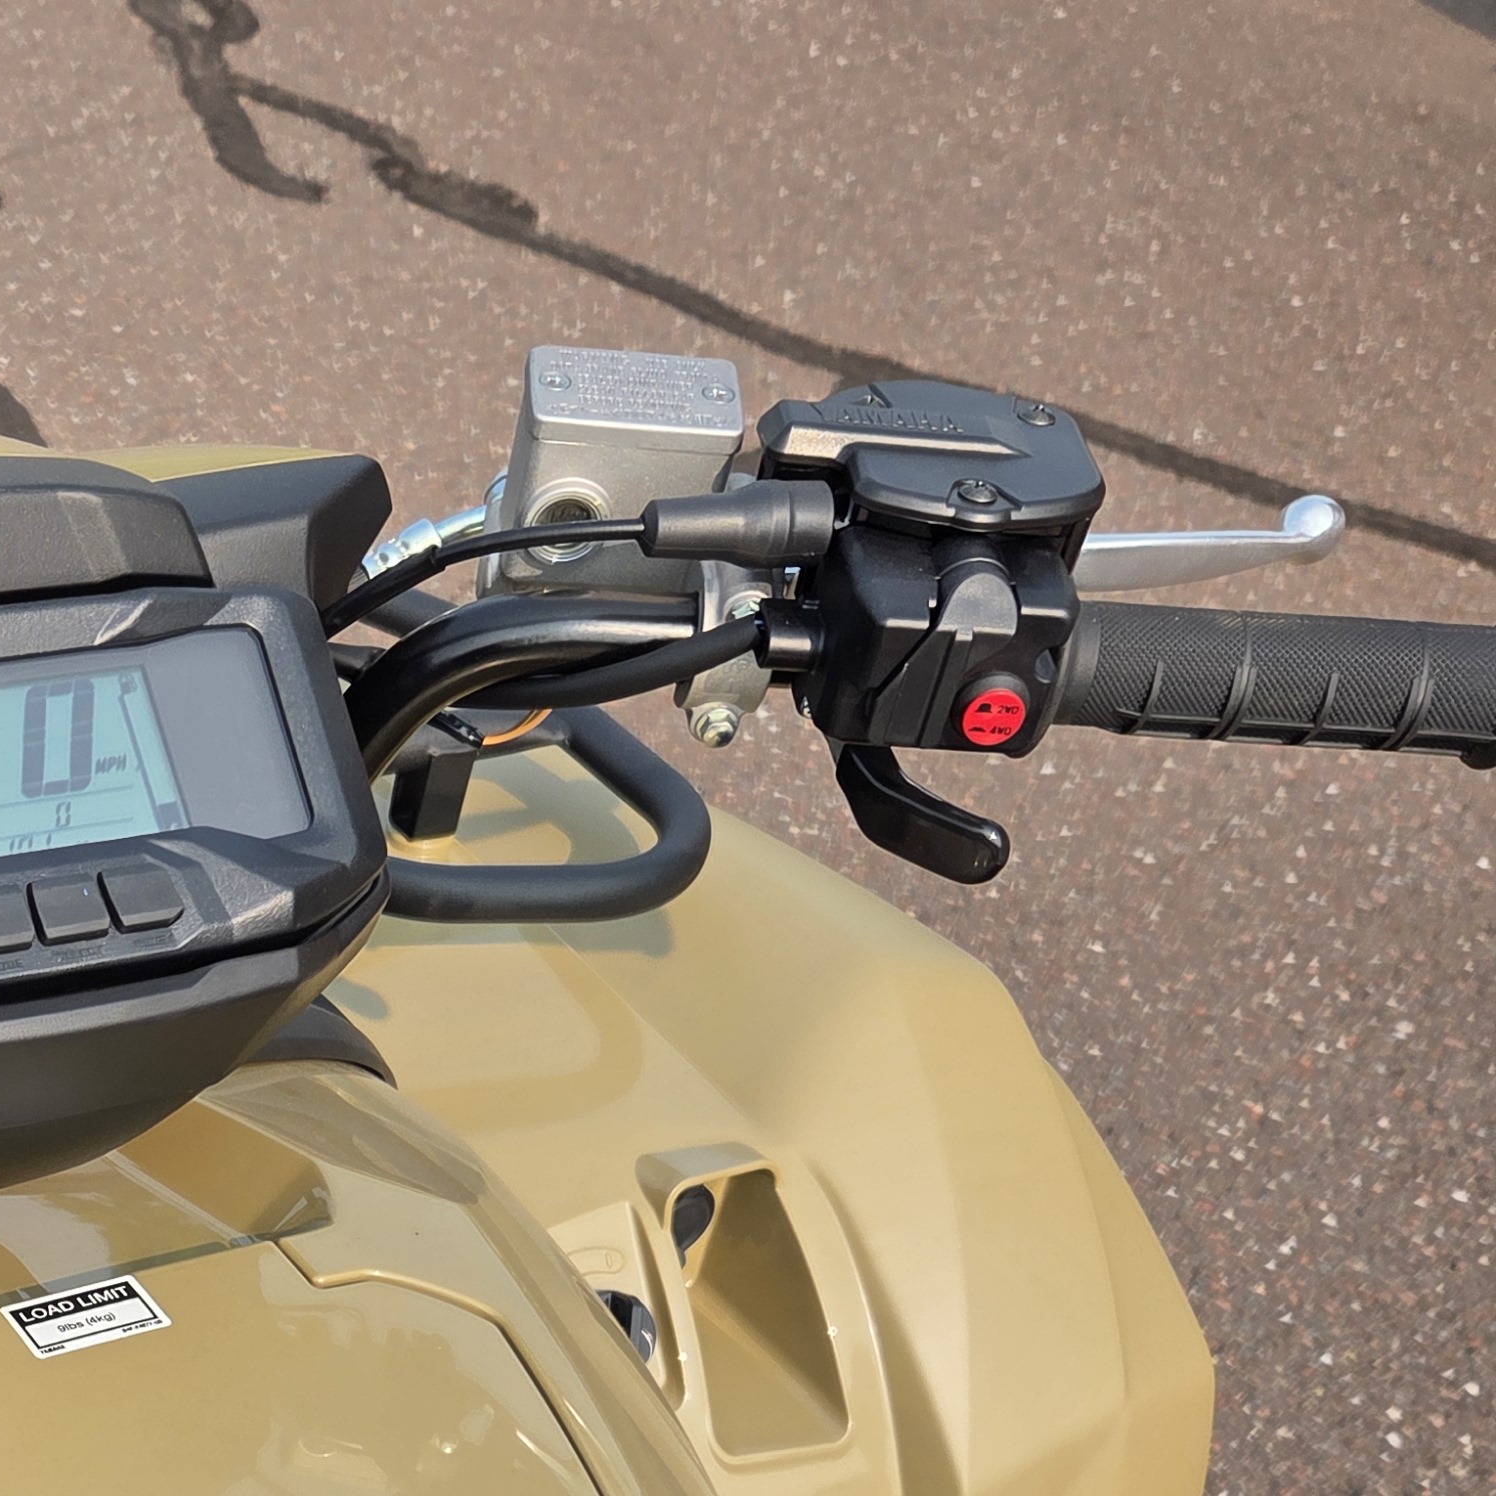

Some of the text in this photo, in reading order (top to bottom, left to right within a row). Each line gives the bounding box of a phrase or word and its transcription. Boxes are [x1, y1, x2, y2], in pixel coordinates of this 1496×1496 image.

[810, 402, 964, 433] YAMAHA
[996, 705, 1020, 715] 2WD
[20, 677, 128, 799] 0 MPH
[989, 726, 1012, 736] 4WD
[18, 1285, 128, 1323] LOAD LIMIT
[57, 1321, 85, 1333] 9lbs
[85, 1312, 117, 1327] (4kg)
